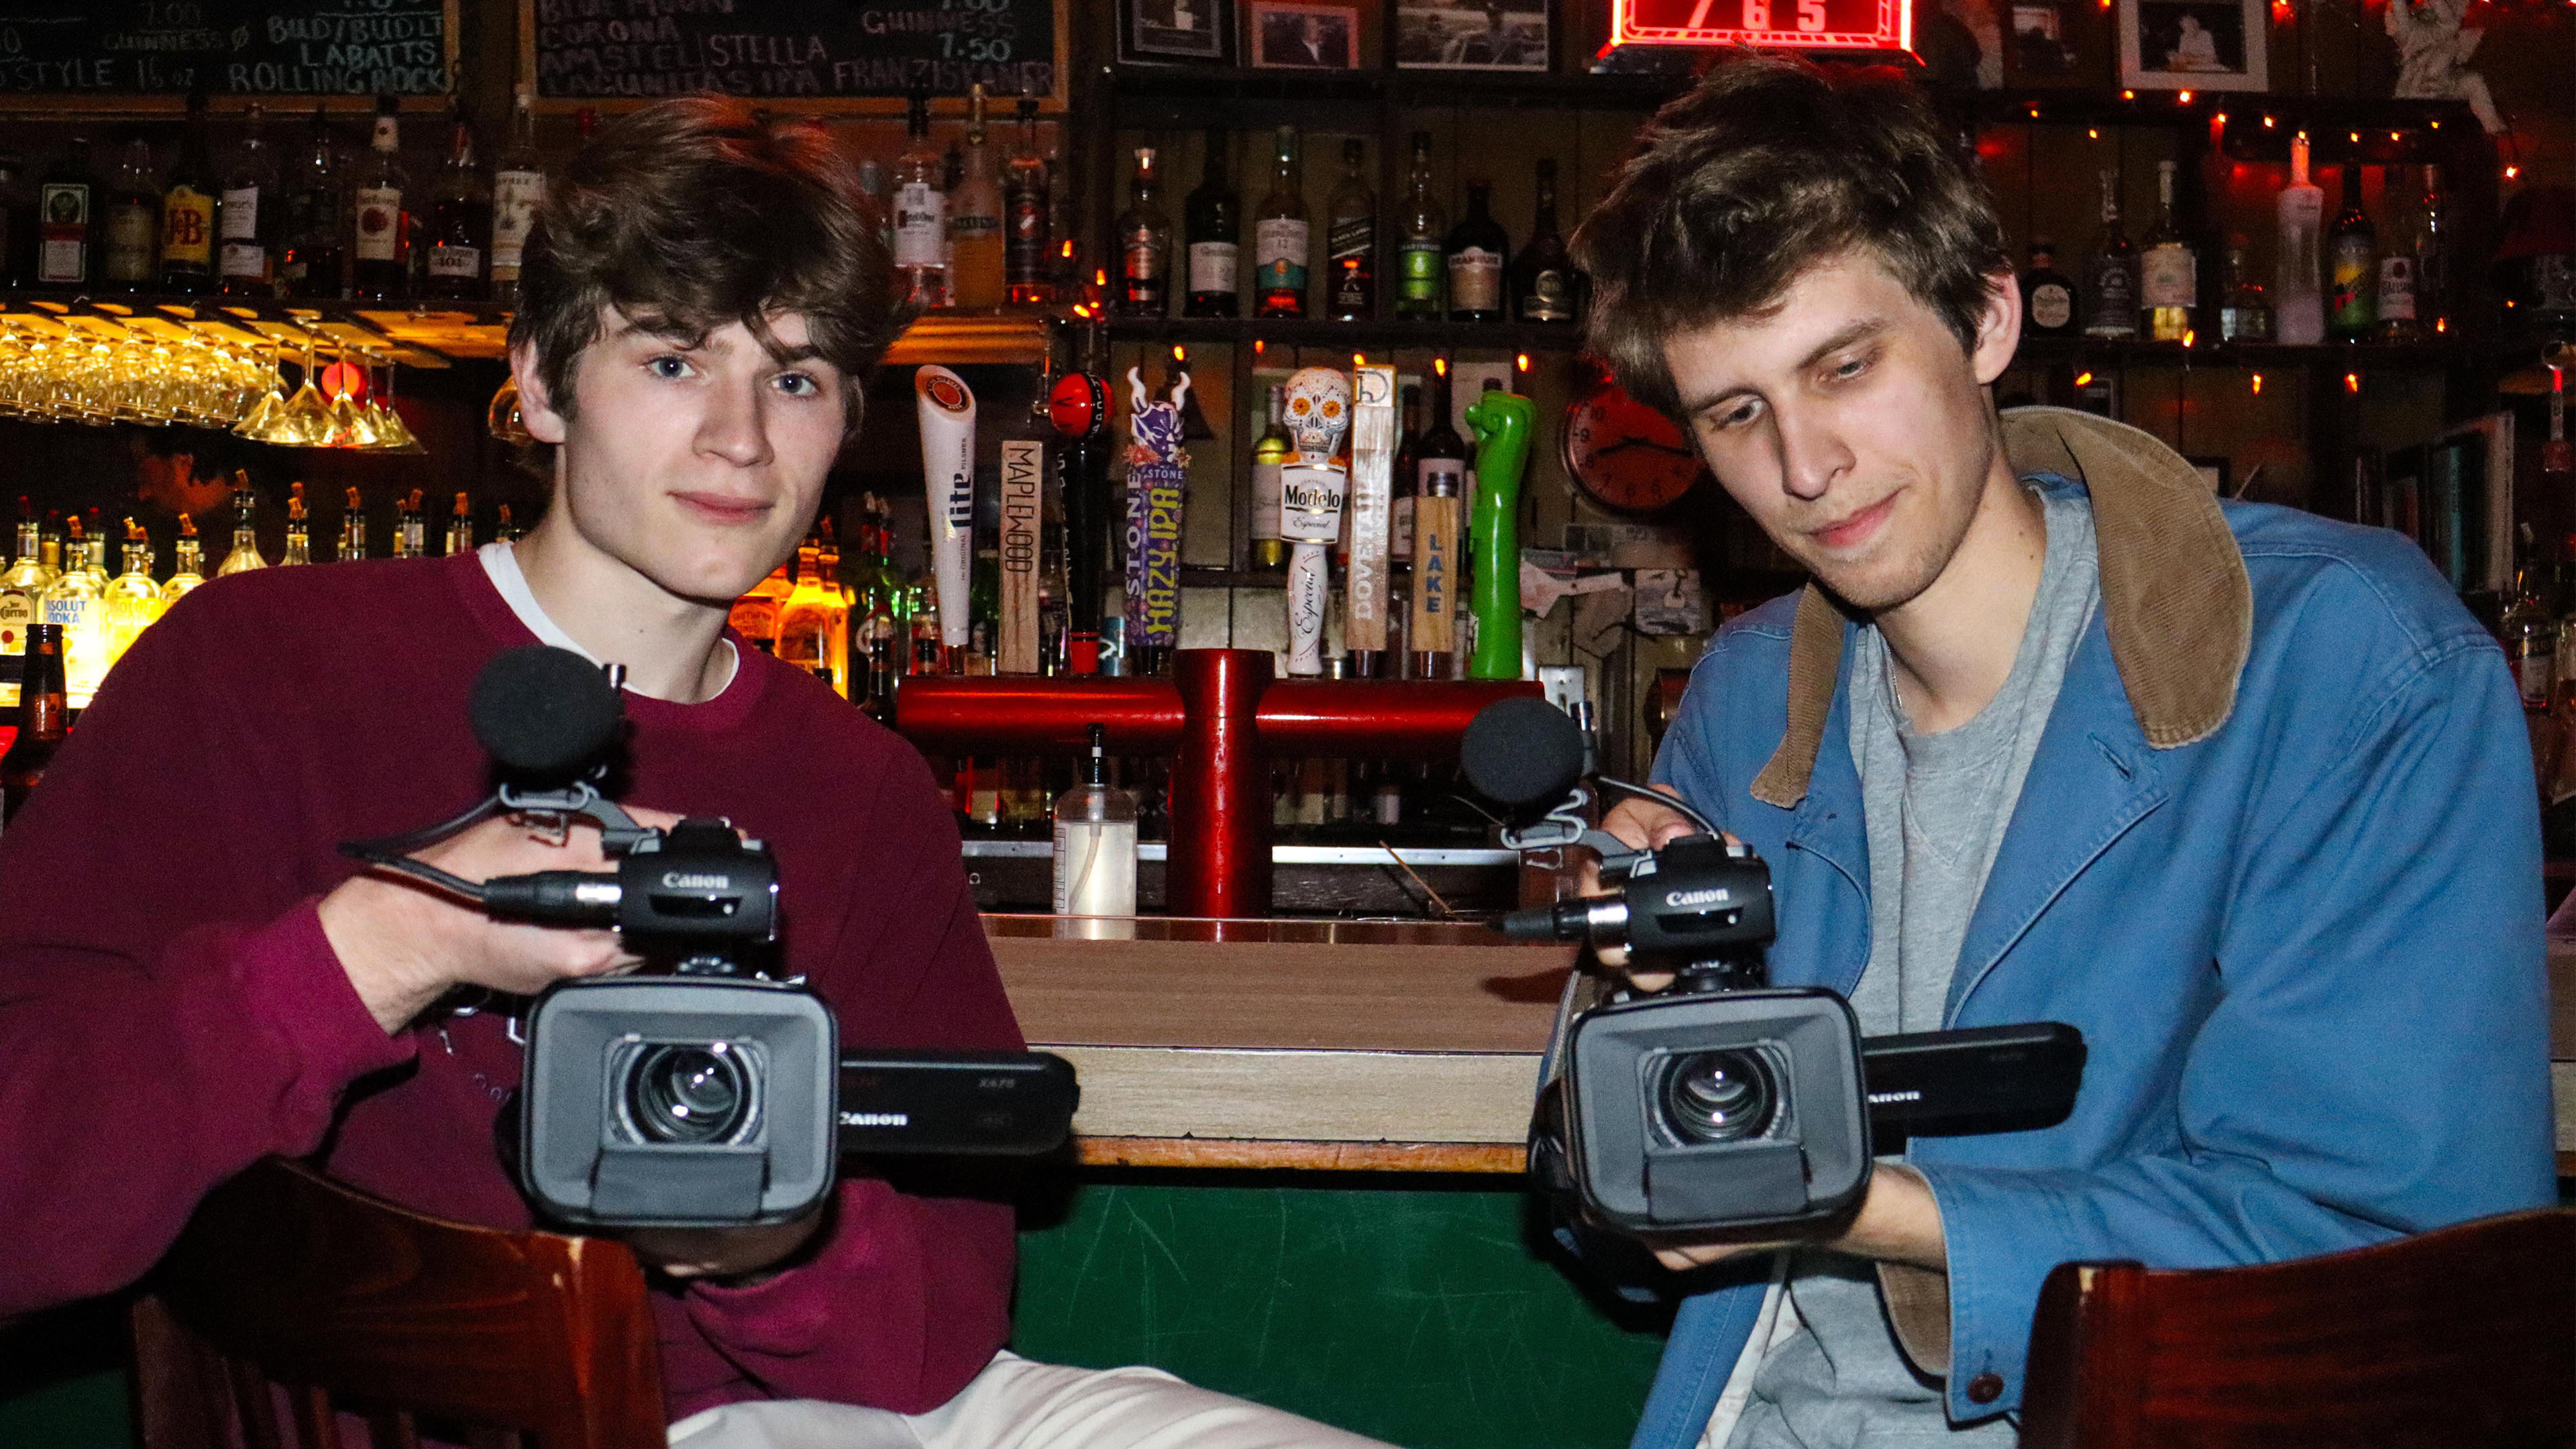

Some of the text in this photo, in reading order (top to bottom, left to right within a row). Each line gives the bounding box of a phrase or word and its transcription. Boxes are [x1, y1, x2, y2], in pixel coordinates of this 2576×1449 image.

[539, 15, 681, 48] CORONA
[861, 10, 1019, 41] GUINNESS
[103, 32, 225, 50] GUINNESS
[301, 40, 437, 68] LABATTS
[938, 32, 1012, 62] 7.50
[15, 58, 115, 91] STYLE
[228, 62, 446, 94] ROLLING ROCK
[544, 68, 752, 95] LAGUNITAS
[833, 58, 1054, 93] FRANZISKANER
[1148, 470, 1183, 480] STONE
[949, 472, 971, 528] lite
[1006, 447, 1034, 574] MAPLEWOOD
[1285, 484, 1340, 508] Modelo
[1126, 472, 1141, 596] STONE
[1293, 516, 1331, 530] Especial
[1146, 487, 1181, 634] HAZY IPA
[1354, 480, 1374, 621] DOVETAIL
[1425, 534, 1444, 614] LAKE
[46, 600, 87, 612] SOLUT
[1294, 568, 1318, 635] Especial
[48, 612, 80, 623] ODKA
[662, 871, 729, 890] Canon
[1666, 888, 1730, 908] Canon
[1867, 1089, 1921, 1104] anon
